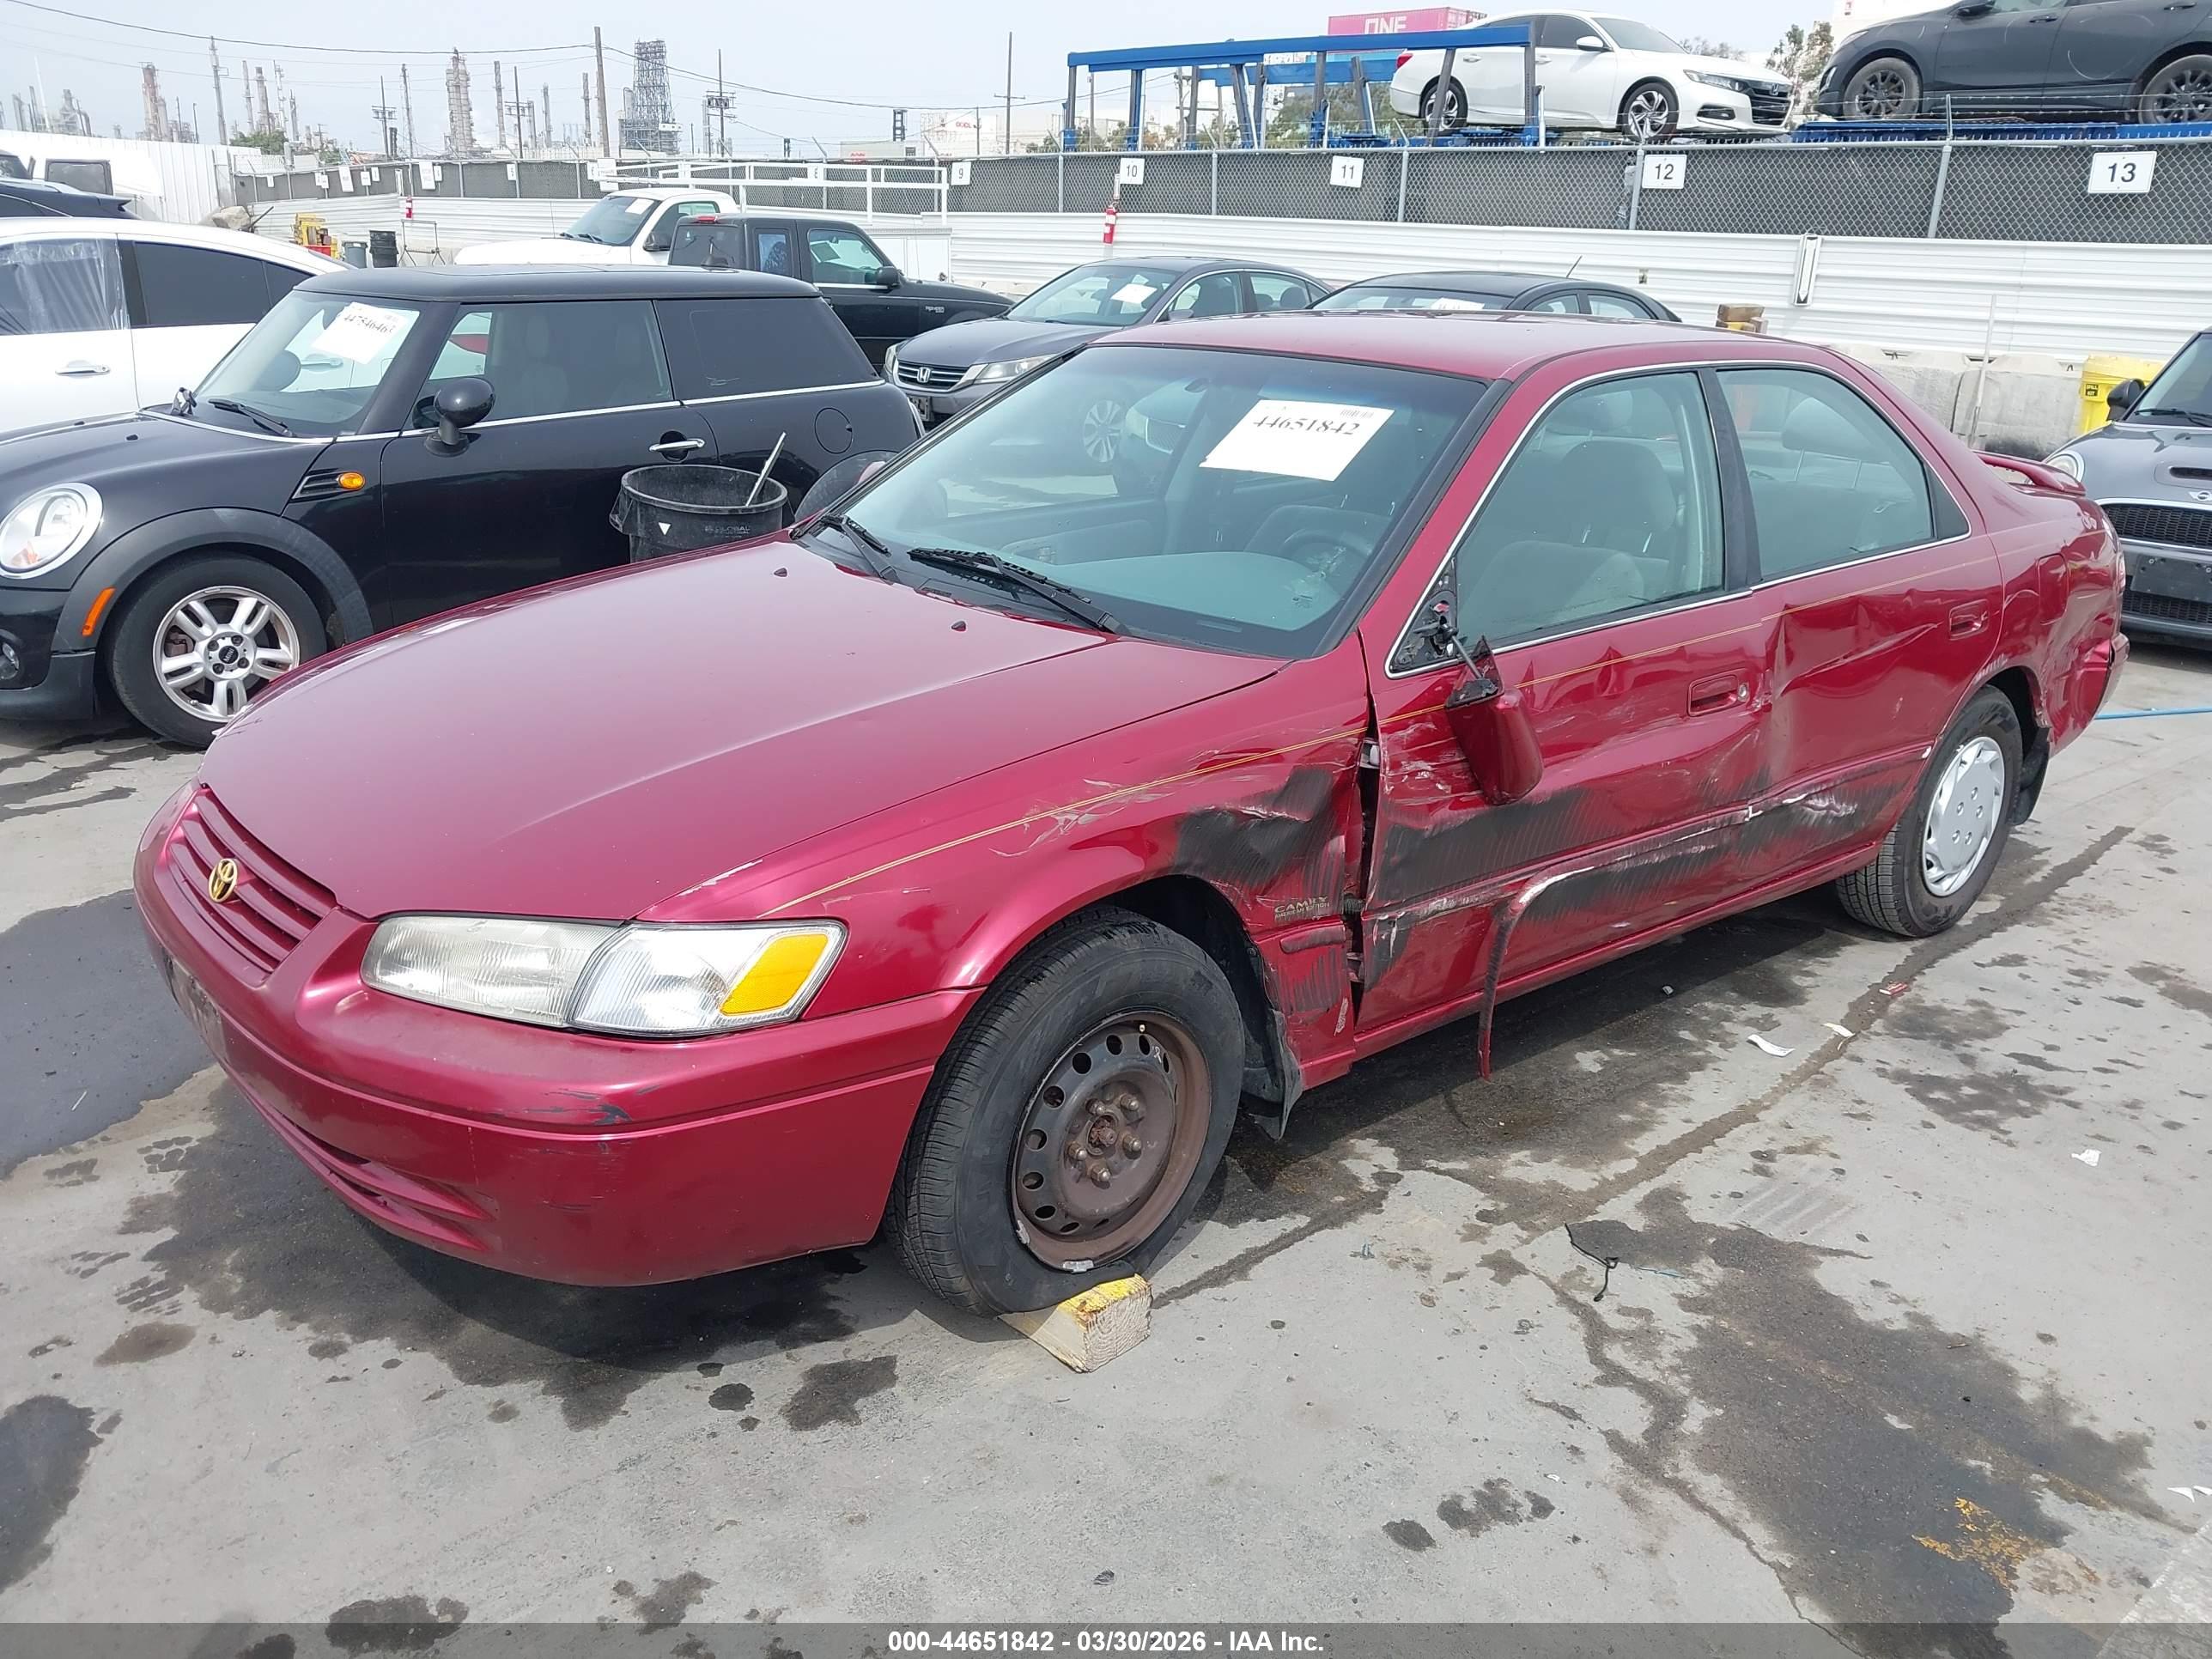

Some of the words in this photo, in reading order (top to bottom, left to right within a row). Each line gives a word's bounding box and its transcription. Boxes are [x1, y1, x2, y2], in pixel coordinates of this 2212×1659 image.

[958, 167, 963, 179] 9
[1127, 165, 1138, 177] 10
[1341, 164, 1354, 179] 11
[1655, 163, 1674, 179] 12
[2108, 162, 2136, 183] 13
[1253, 416, 1361, 435] 44651842
